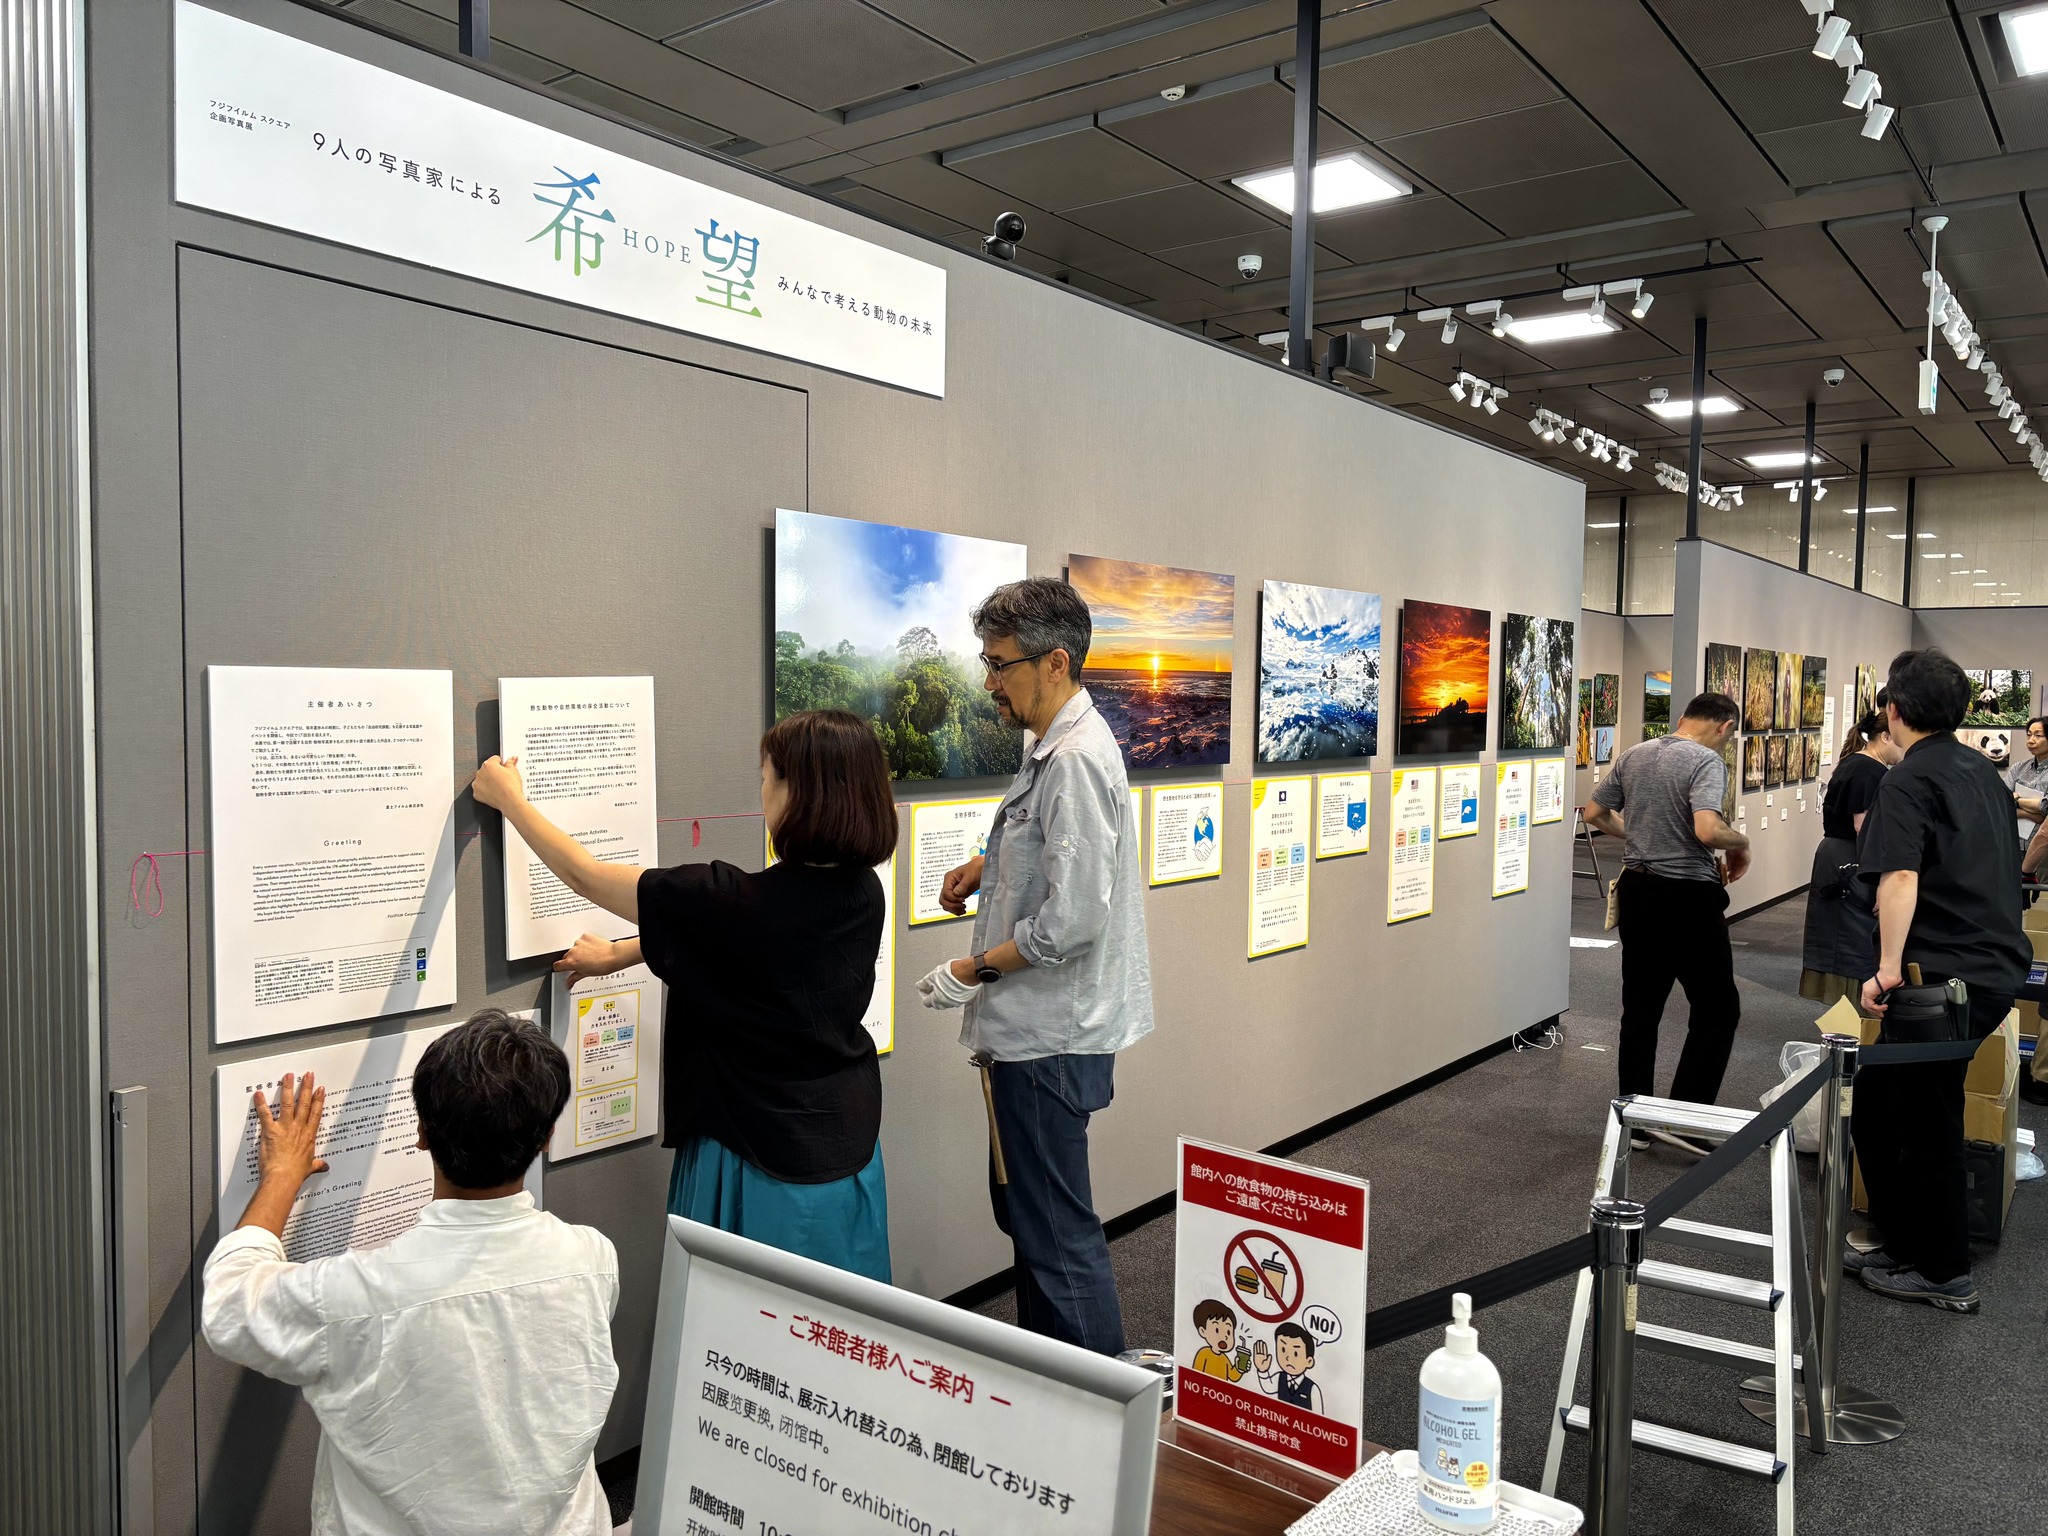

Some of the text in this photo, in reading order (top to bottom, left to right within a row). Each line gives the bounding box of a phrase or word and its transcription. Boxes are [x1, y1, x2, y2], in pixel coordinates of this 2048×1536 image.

[209, 111, 254, 132] 企画写真展
[210, 99, 291, 130] フジフイルム スクエア
[313, 132, 501, 205] 9人の写真家による
[526, 166, 762, 318] 希 HOPE 望
[777, 276, 932, 336] みんなで考える動物の未来
[307, 700, 373, 709] 主催者あいさつ
[323, 838, 362, 847] Greeting
[295, 1180, 362, 1203] pervisor's Greeting
[1191, 1163, 1348, 1217] 館内への飲食物の持ち込みは
[1225, 1190, 1308, 1222] ご遠慮ください
[1309, 1313, 1336, 1335] NO!
[790, 1314, 974, 1404] ご来館者様へご案内
[704, 1349, 1076, 1515] 只今の時間は、展示入れ替えの為、閉館しております
[1184, 1379, 1349, 1448] NO FOOD OR DRINK ALLOWED
[1423, 1414, 1459, 1440] ALCOHOL
[1461, 1427, 1481, 1441] GEL
[698, 1415, 932, 1536] We are closed for exhibition
[689, 1485, 745, 1530] 開館時間
